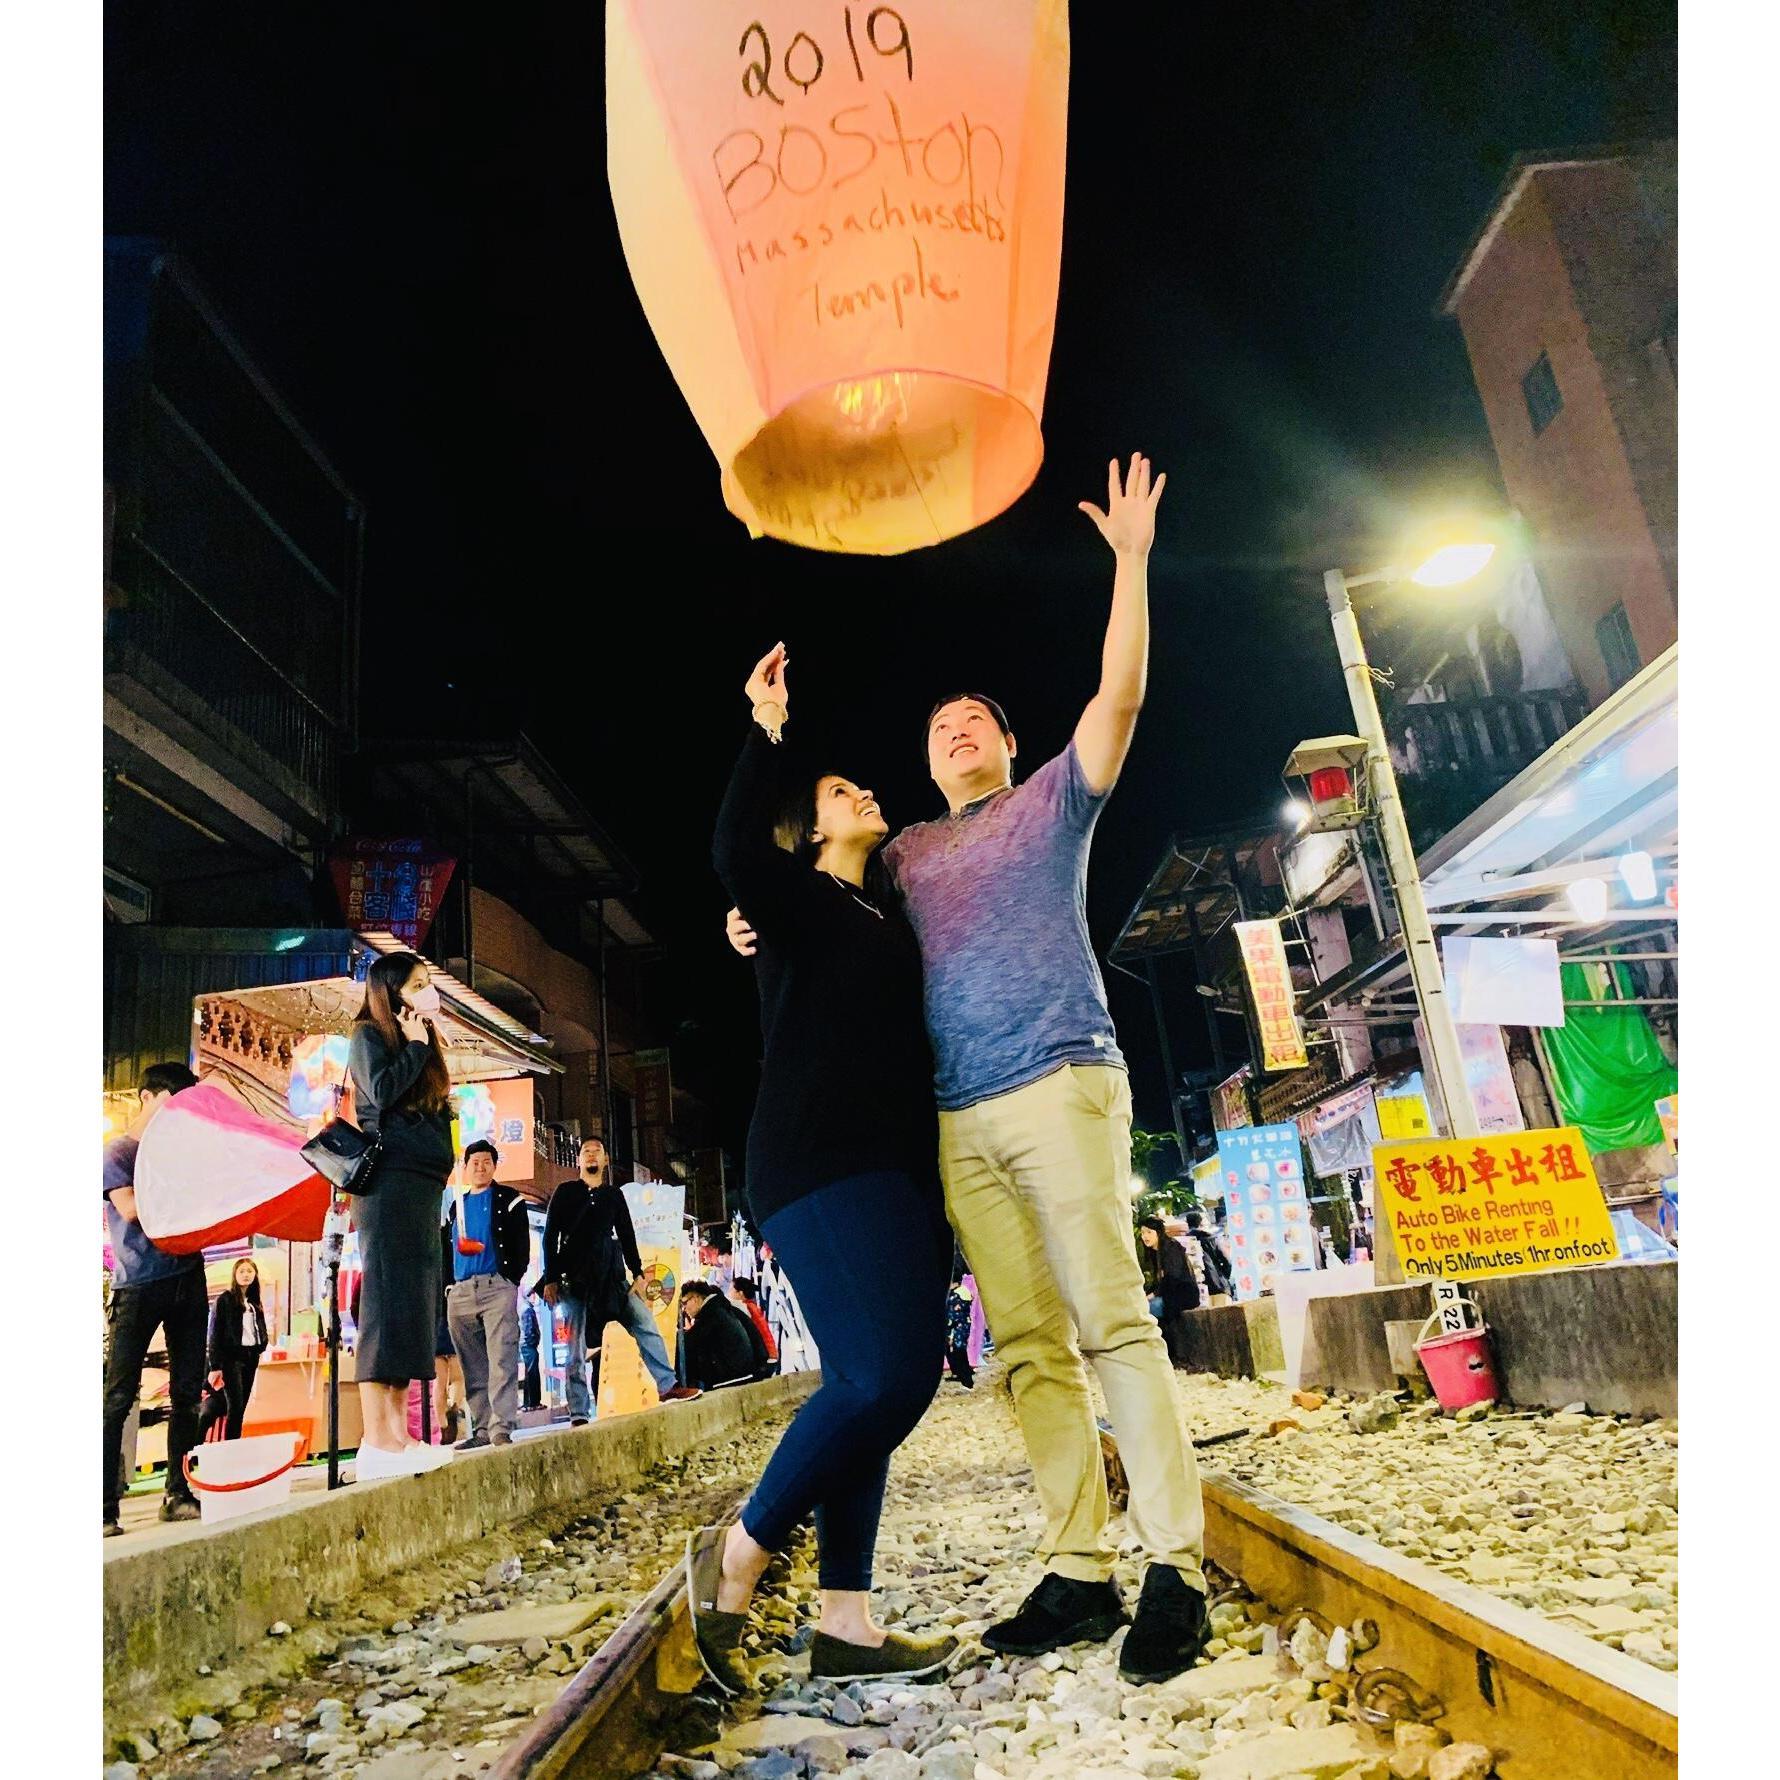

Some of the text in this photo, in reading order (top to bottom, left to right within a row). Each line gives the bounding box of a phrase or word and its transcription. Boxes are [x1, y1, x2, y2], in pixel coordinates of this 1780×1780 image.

[739, 6, 913, 106] 2019
[1385, 1143, 1586, 1201] 電動車出租
[1396, 1199, 1554, 1230] Auto Bike Renting
[1400, 1234, 1426, 1253] To
[1431, 1231, 1460, 1250] the
[1463, 1225, 1518, 1246] Water
[1406, 1257, 1443, 1277] Only
